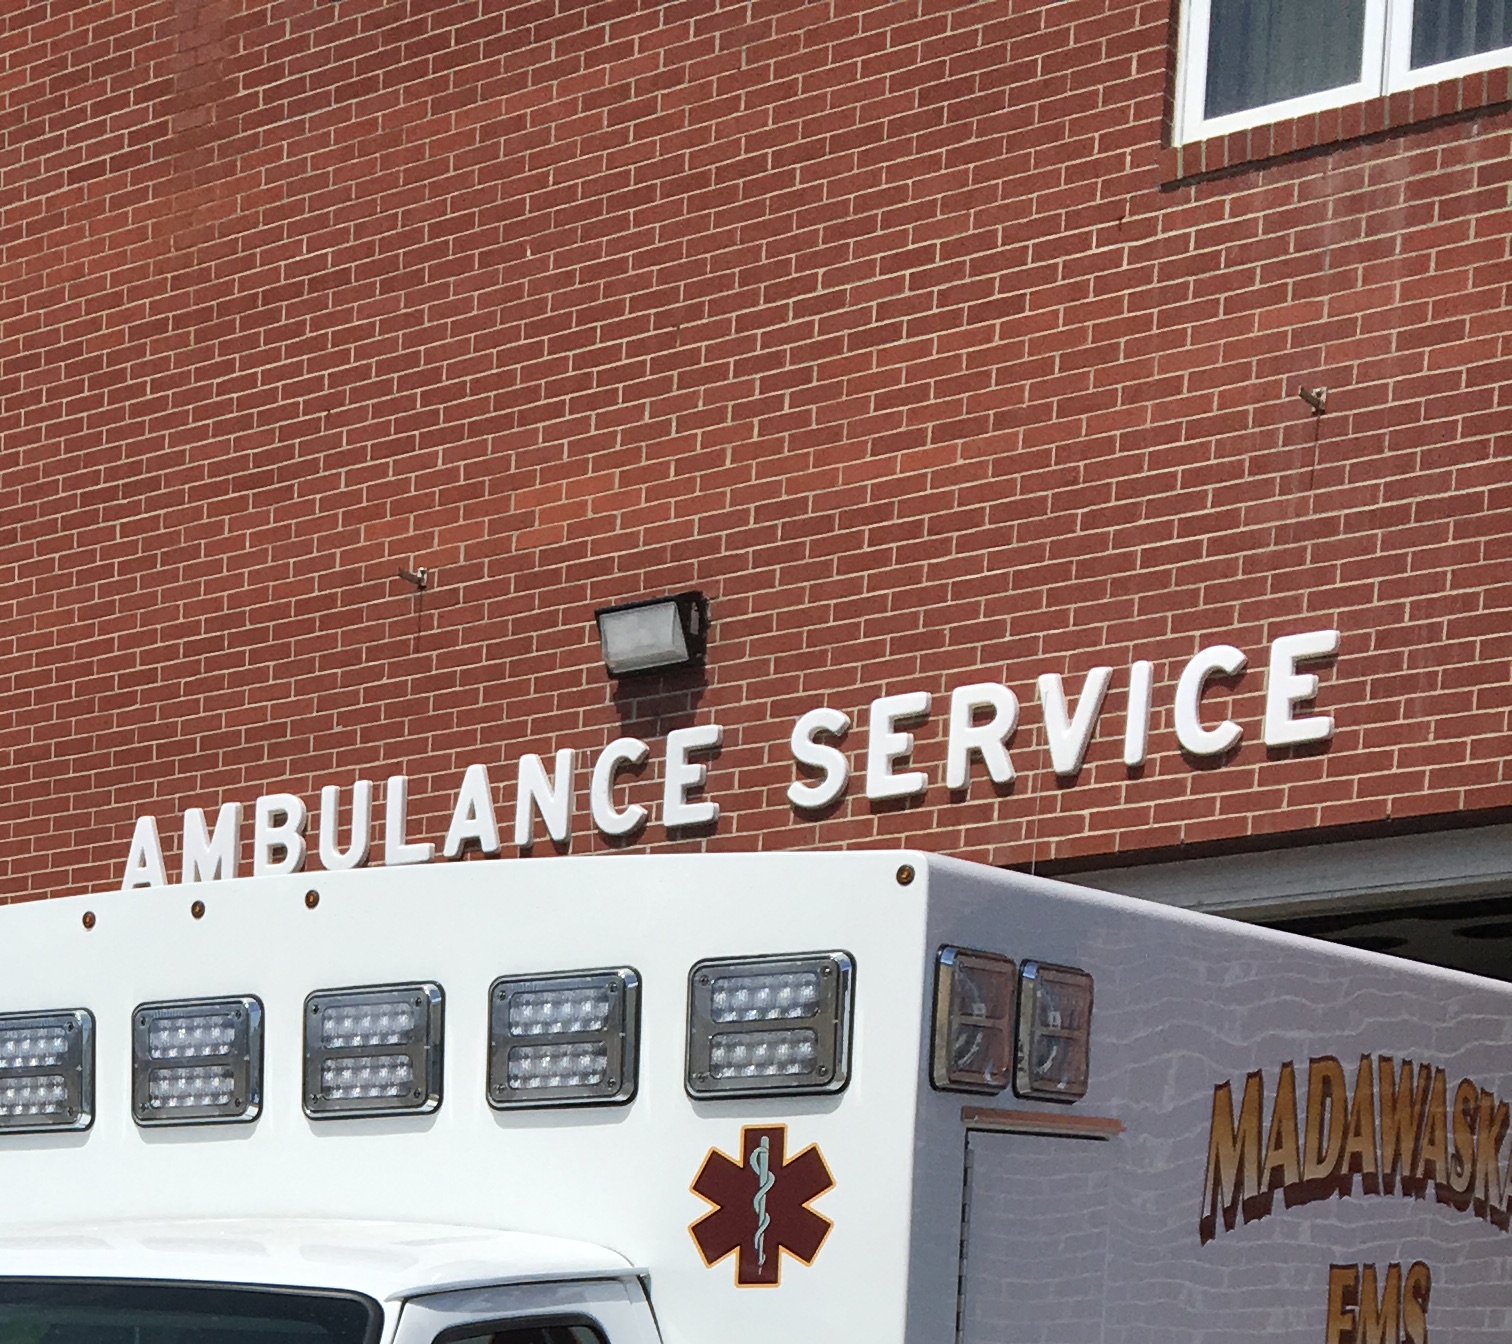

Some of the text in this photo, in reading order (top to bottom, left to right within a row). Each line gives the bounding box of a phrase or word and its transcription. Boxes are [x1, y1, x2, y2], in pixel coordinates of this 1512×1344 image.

[120, 629, 1341, 890] AMBULANCE SERVICE
[1199, 1053, 1512, 1246] MADAWASK
